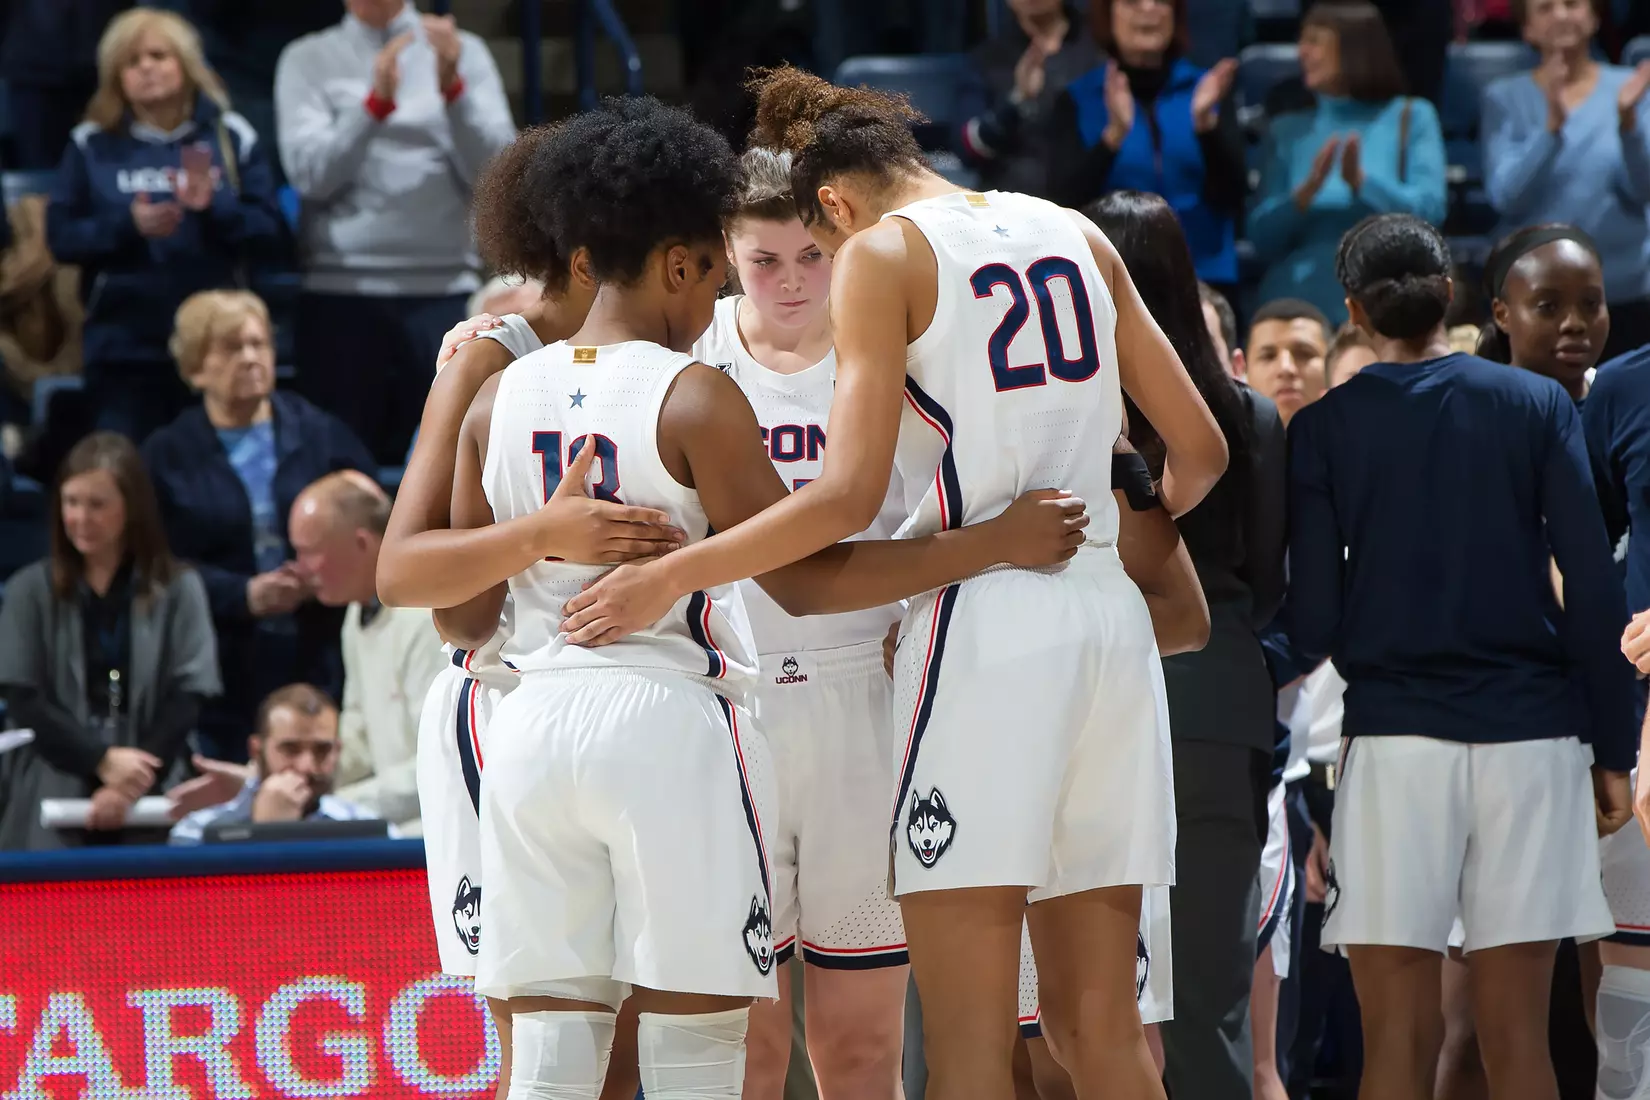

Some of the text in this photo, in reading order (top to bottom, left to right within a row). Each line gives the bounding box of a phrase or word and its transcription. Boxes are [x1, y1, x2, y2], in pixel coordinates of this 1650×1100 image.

[116, 167, 222, 193] UCO
[969, 256, 1100, 392] 20
[775, 674, 808, 684] UCONN
[0, 972, 501, 1100] ARGO
